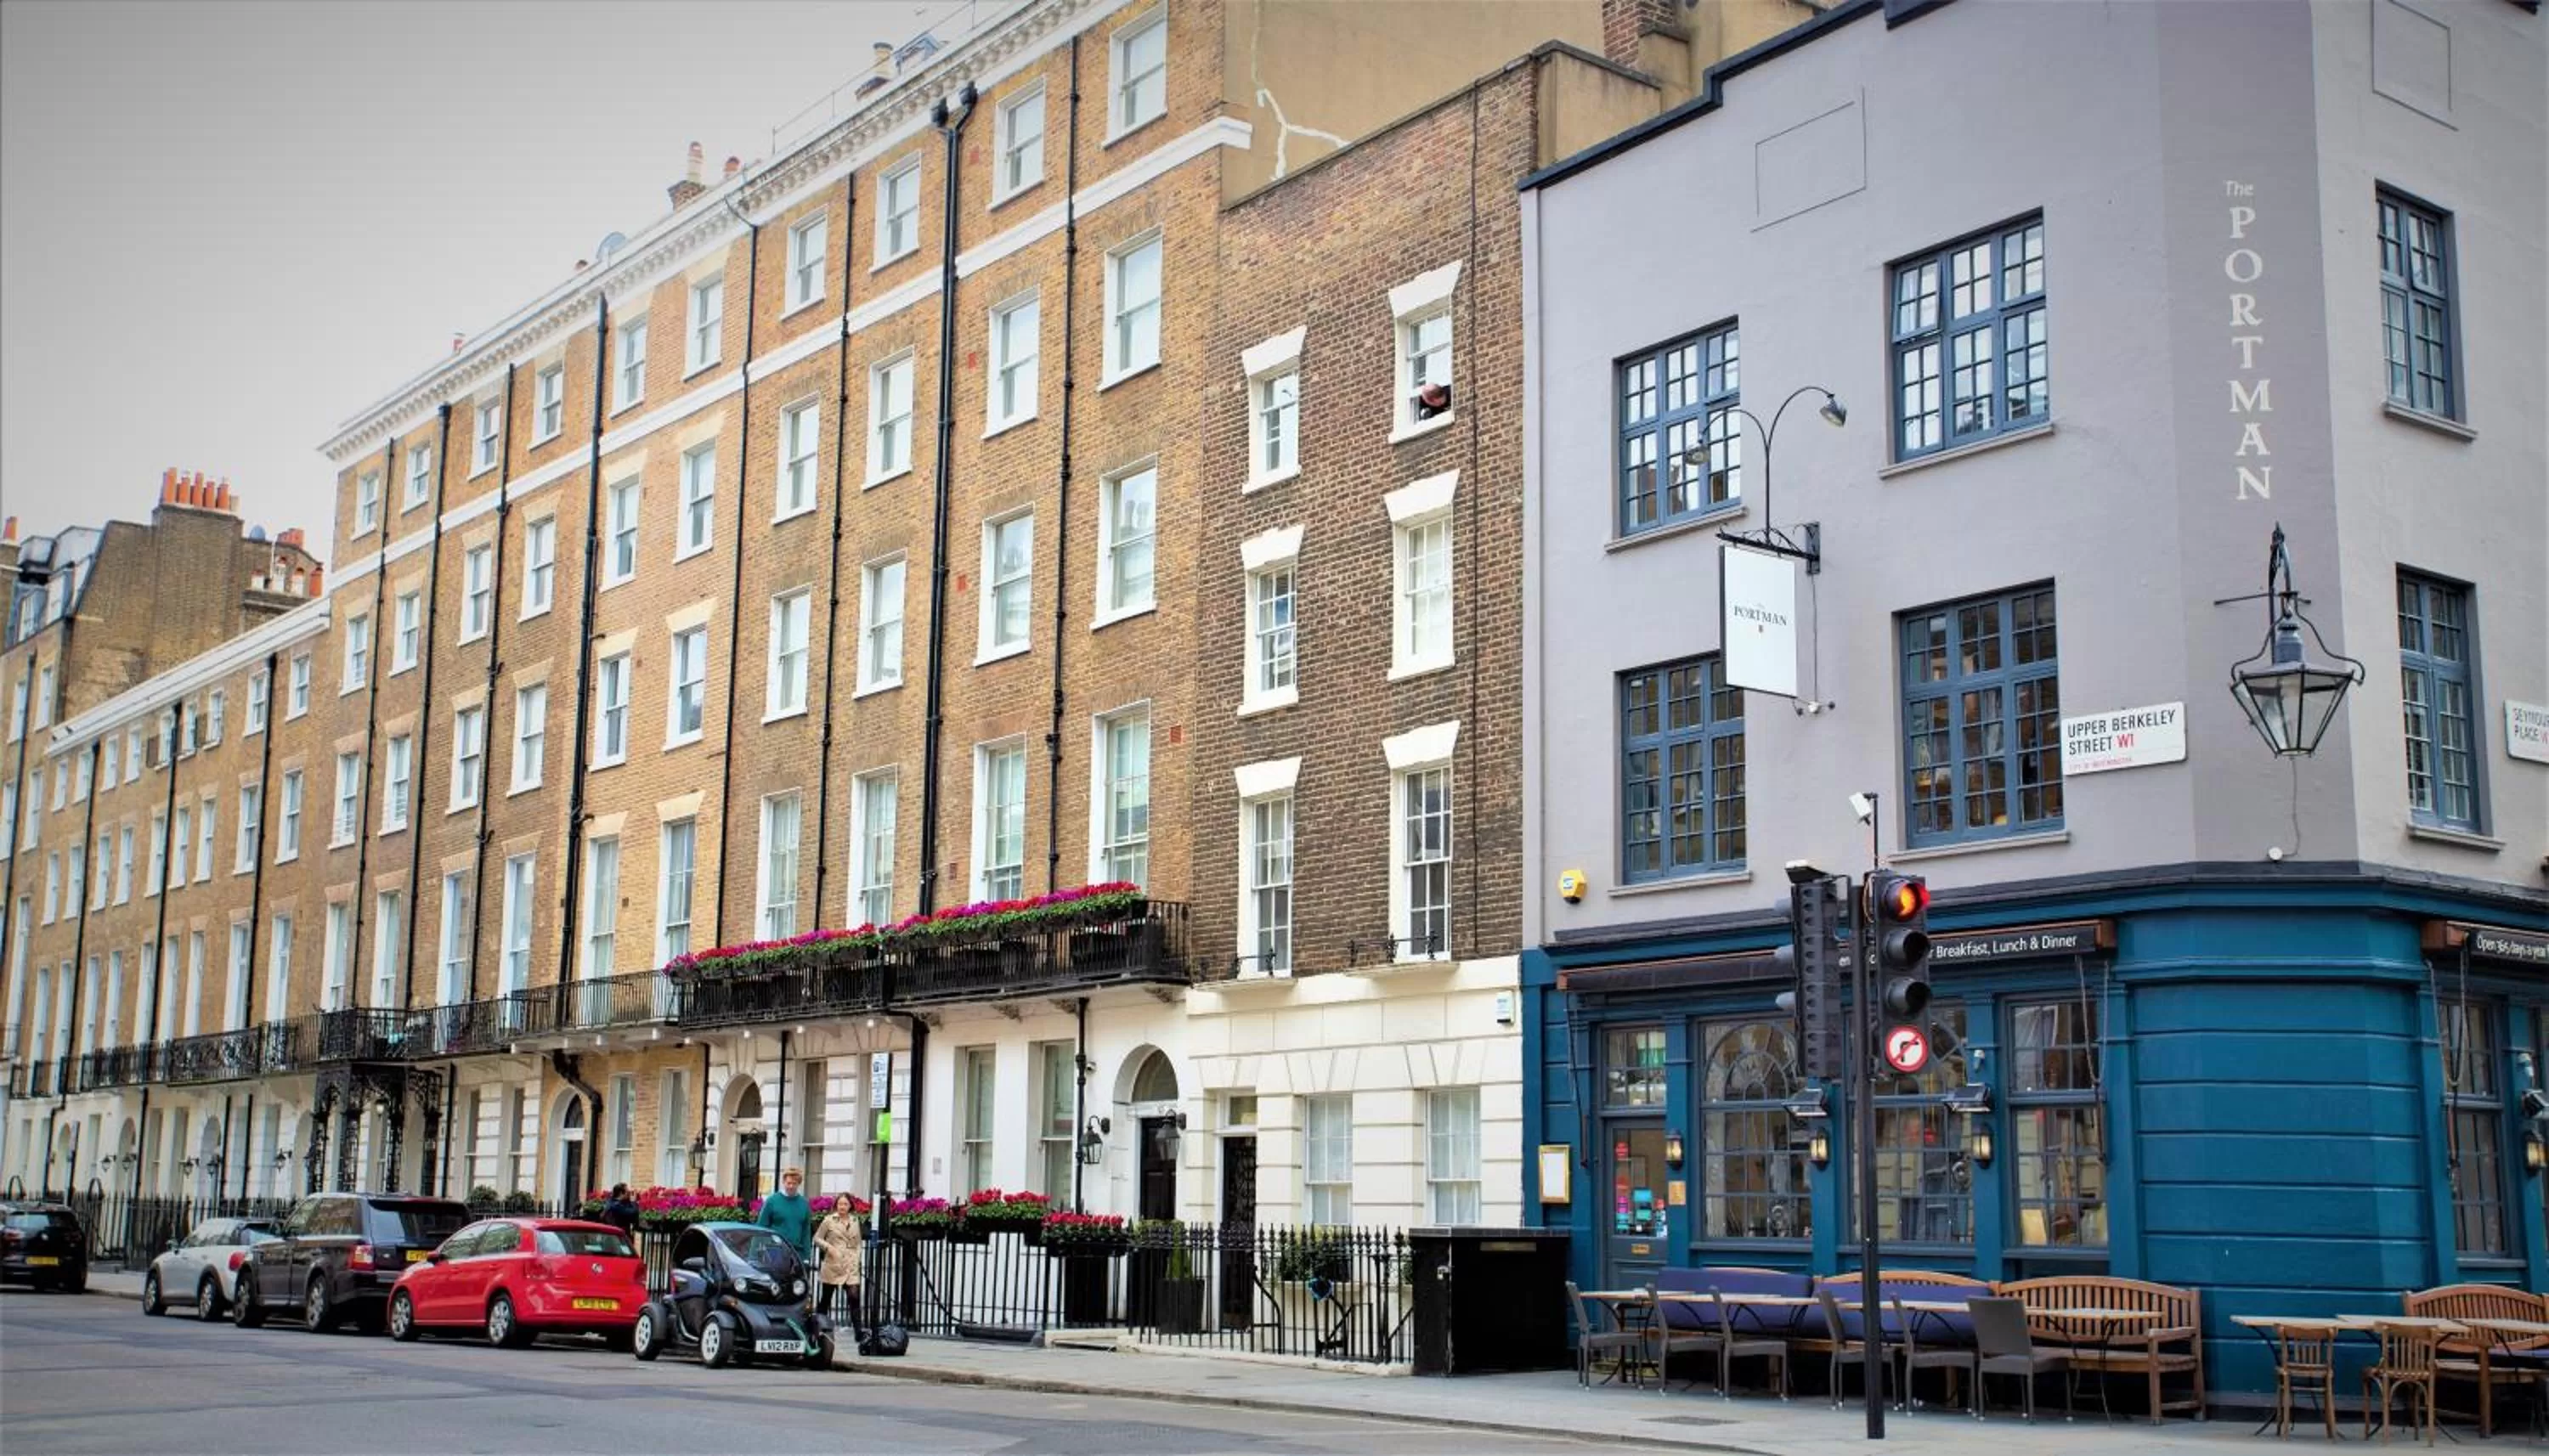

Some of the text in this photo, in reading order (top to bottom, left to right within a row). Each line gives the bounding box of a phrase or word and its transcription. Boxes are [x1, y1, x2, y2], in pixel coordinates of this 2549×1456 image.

[2226, 180, 2254, 197] The
[2224, 206, 2274, 500] PORTMAN
[1733, 605, 1787, 626] PORTMAN
[2067, 709, 2176, 738] UPPER BERKELEY
[2514, 723, 2540, 742] PLACE
[2069, 733, 2134, 755] STREET W1
[1936, 940, 1991, 958] Breakfast,
[1992, 937, 2026, 954] Lunch
[2029, 935, 2038, 950] &
[2042, 934, 2077, 949] Dinner
[2477, 934, 2496, 952] Open
